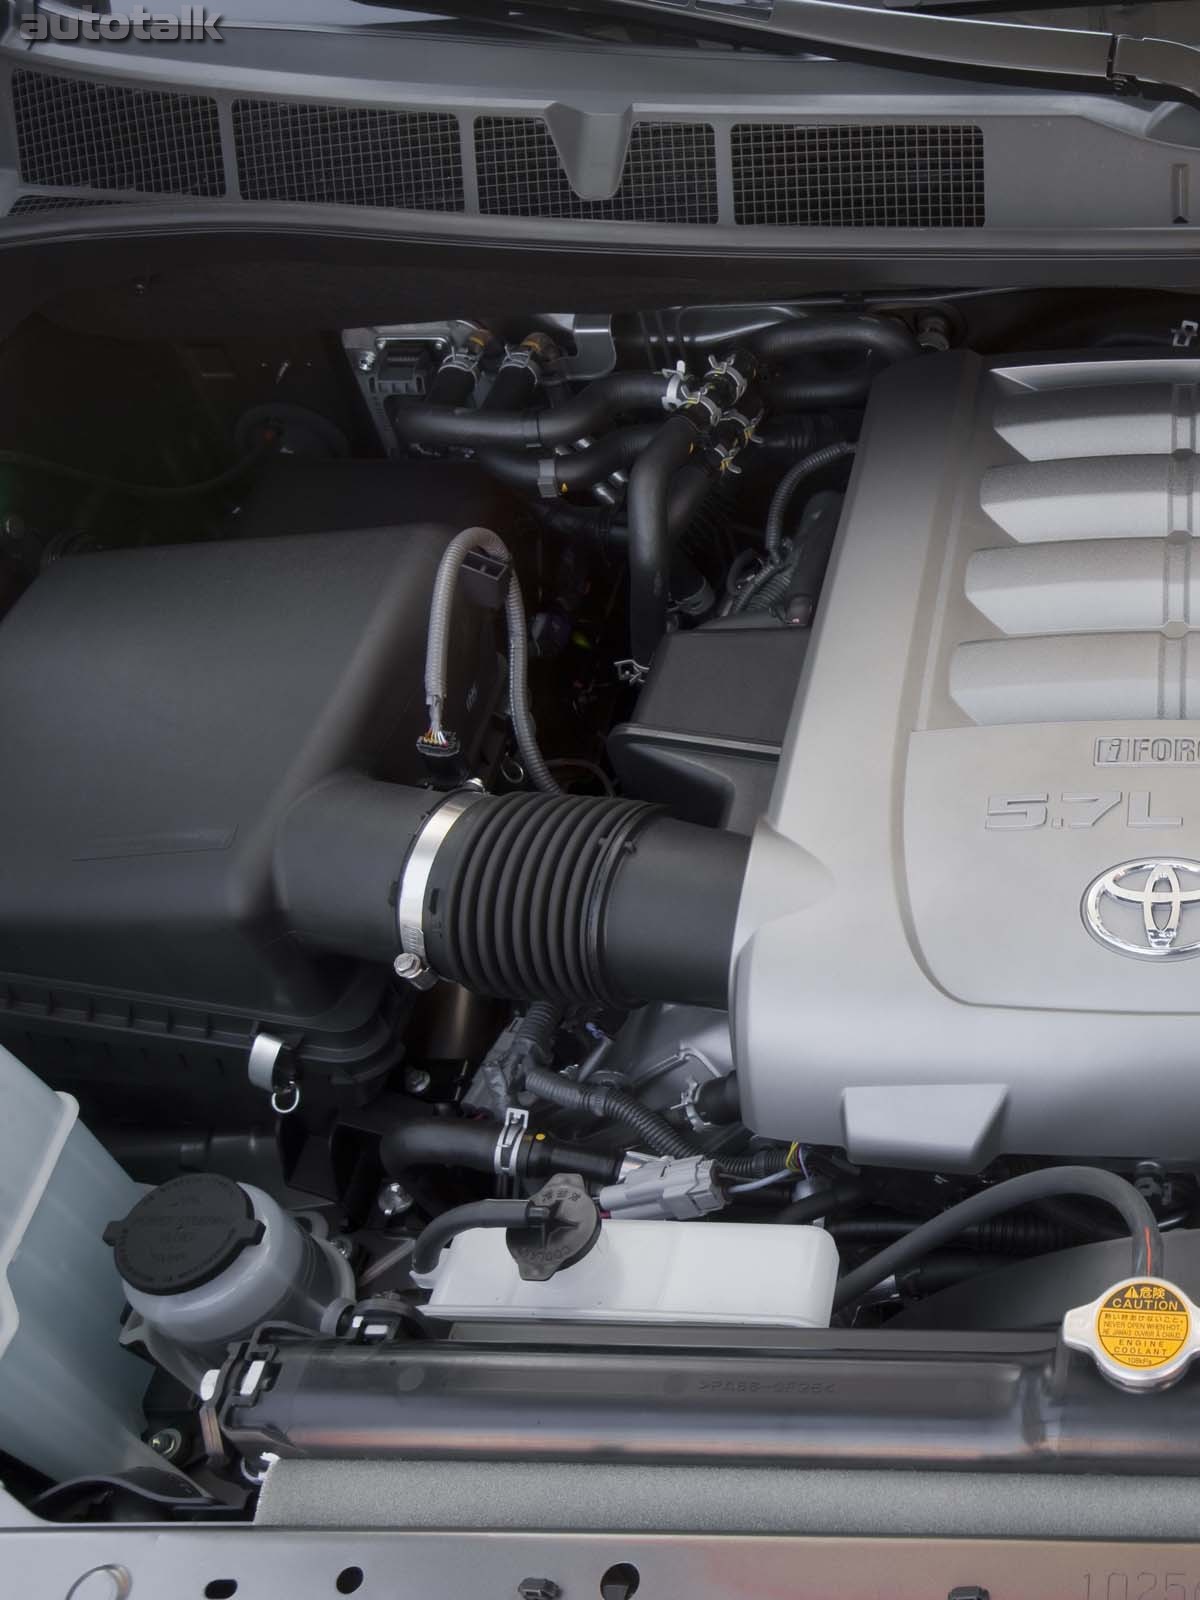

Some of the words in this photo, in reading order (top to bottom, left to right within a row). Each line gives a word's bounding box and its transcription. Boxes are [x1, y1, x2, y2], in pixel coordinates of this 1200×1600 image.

[985, 792, 1183, 830] 5.7L
[1112, 1298, 1178, 1311] CAUTION
[1119, 1339, 1165, 1348] ENGINE
[1114, 1346, 1168, 1356] COOLANT
